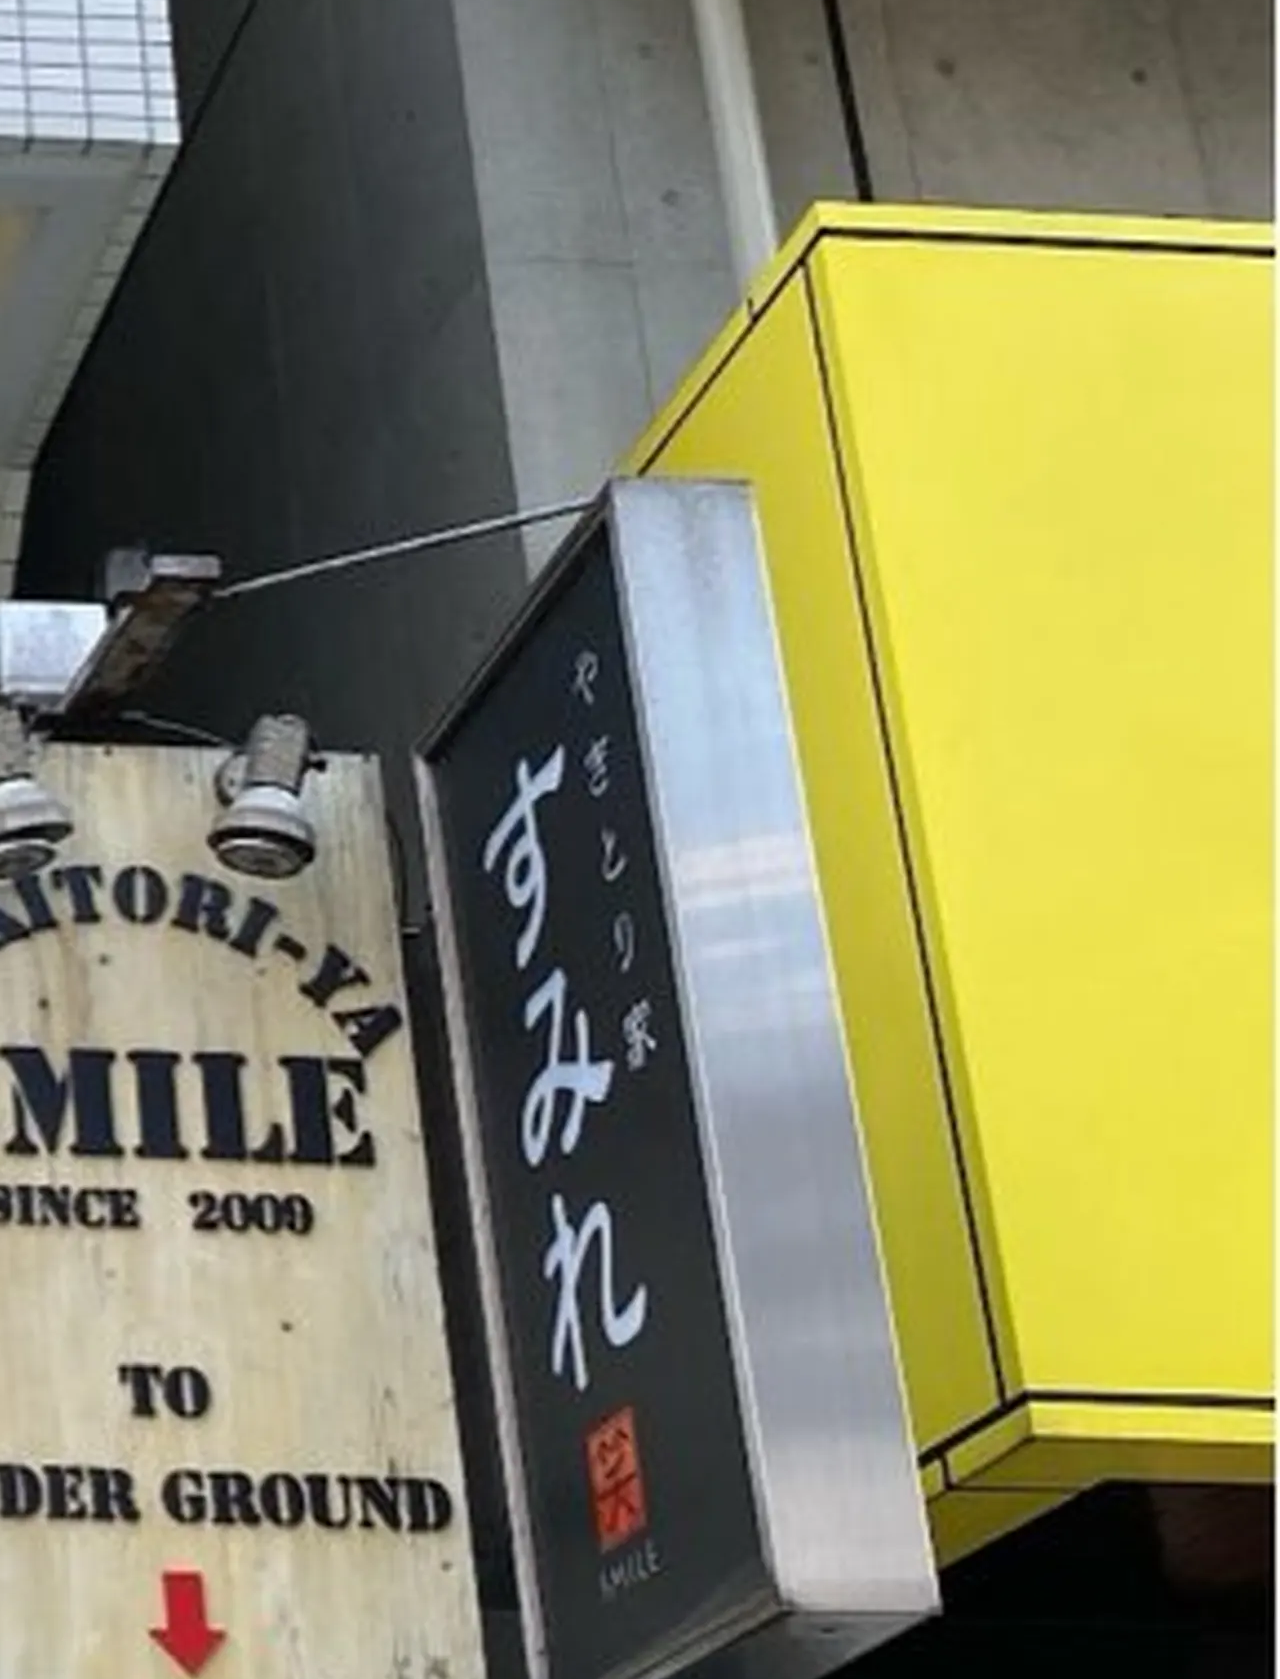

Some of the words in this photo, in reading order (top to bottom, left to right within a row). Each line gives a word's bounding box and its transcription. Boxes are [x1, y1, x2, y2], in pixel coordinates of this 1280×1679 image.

[484, 744, 647, 1392] すみれ
[118, 1363, 211, 1420] TO
[162, 1469, 453, 1534] GROUND
